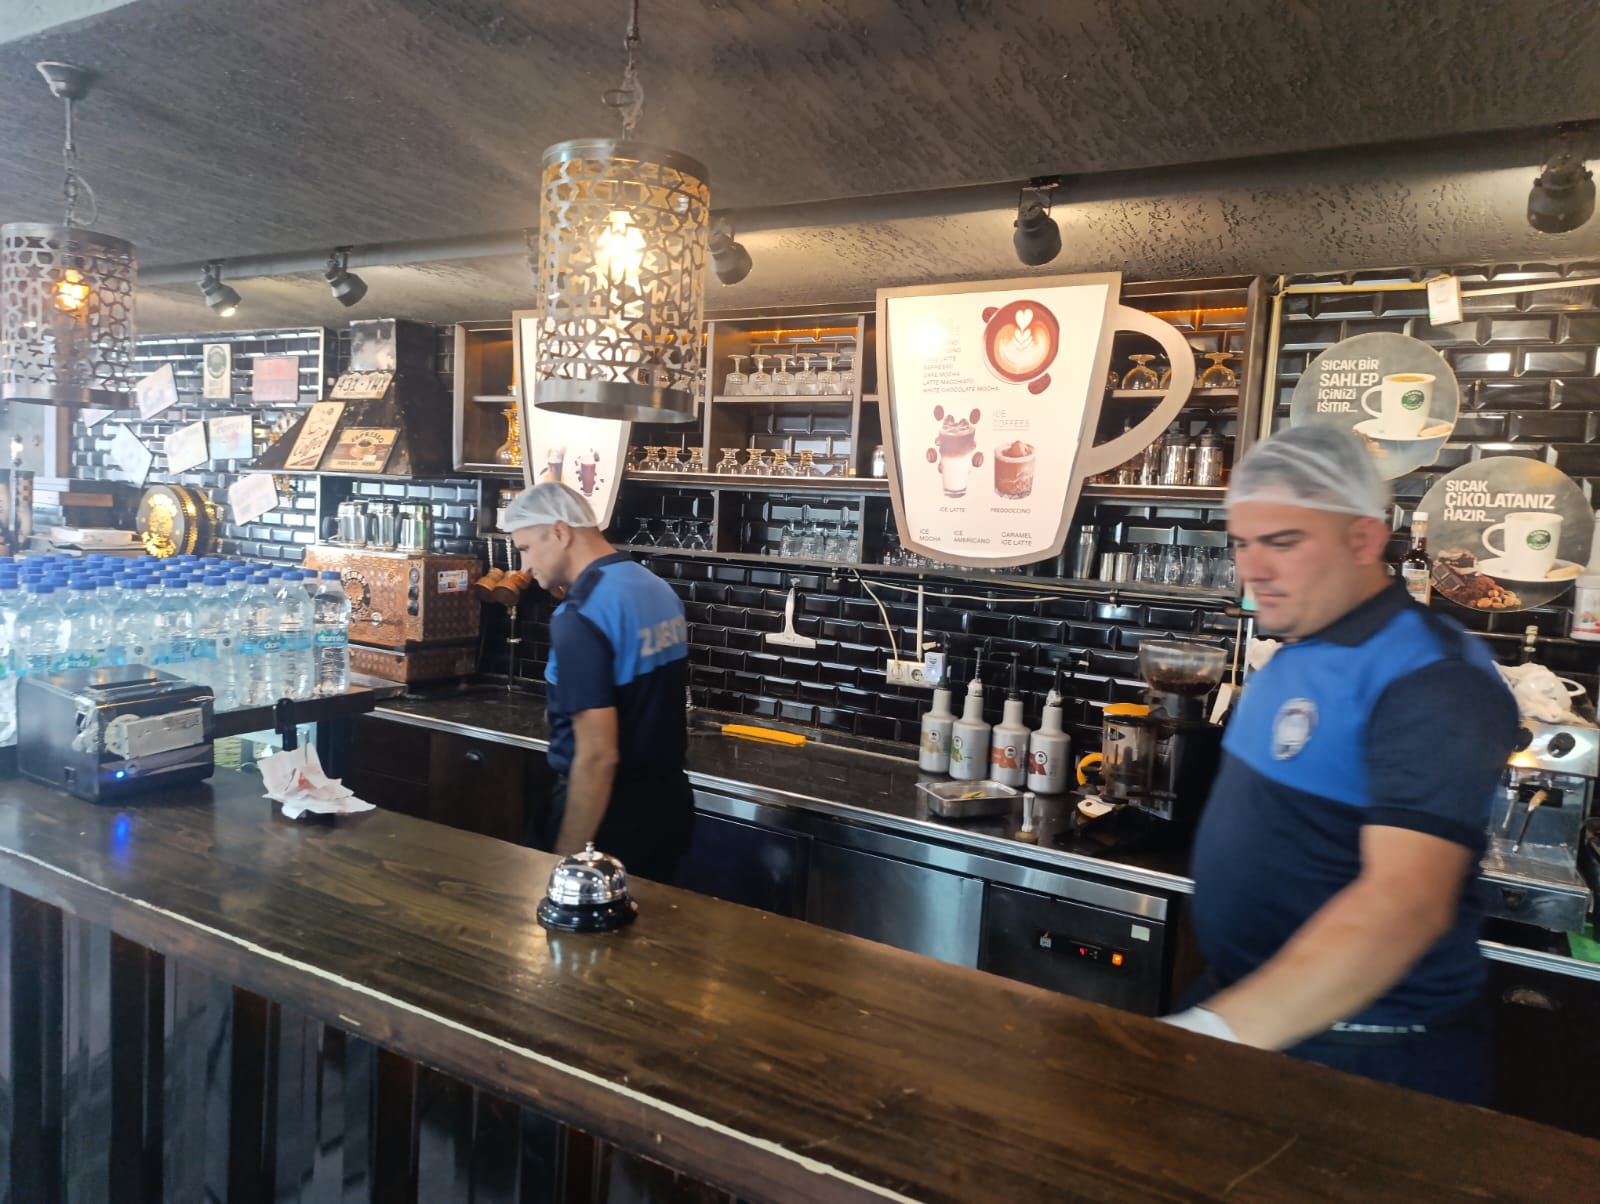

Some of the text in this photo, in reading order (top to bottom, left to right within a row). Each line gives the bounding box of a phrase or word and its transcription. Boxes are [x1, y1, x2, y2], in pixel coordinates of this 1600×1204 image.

[1321, 357, 1379, 371] SICAK BİR
[1319, 372, 1380, 387] SAHLEP
[1318, 388, 1357, 402] İÇİNİZİ
[1445, 480, 1488, 492] SICAK
[1445, 492, 1556, 509] ÇİKOLATANIZ
[1001, 531, 1032, 539] CARAMEL
